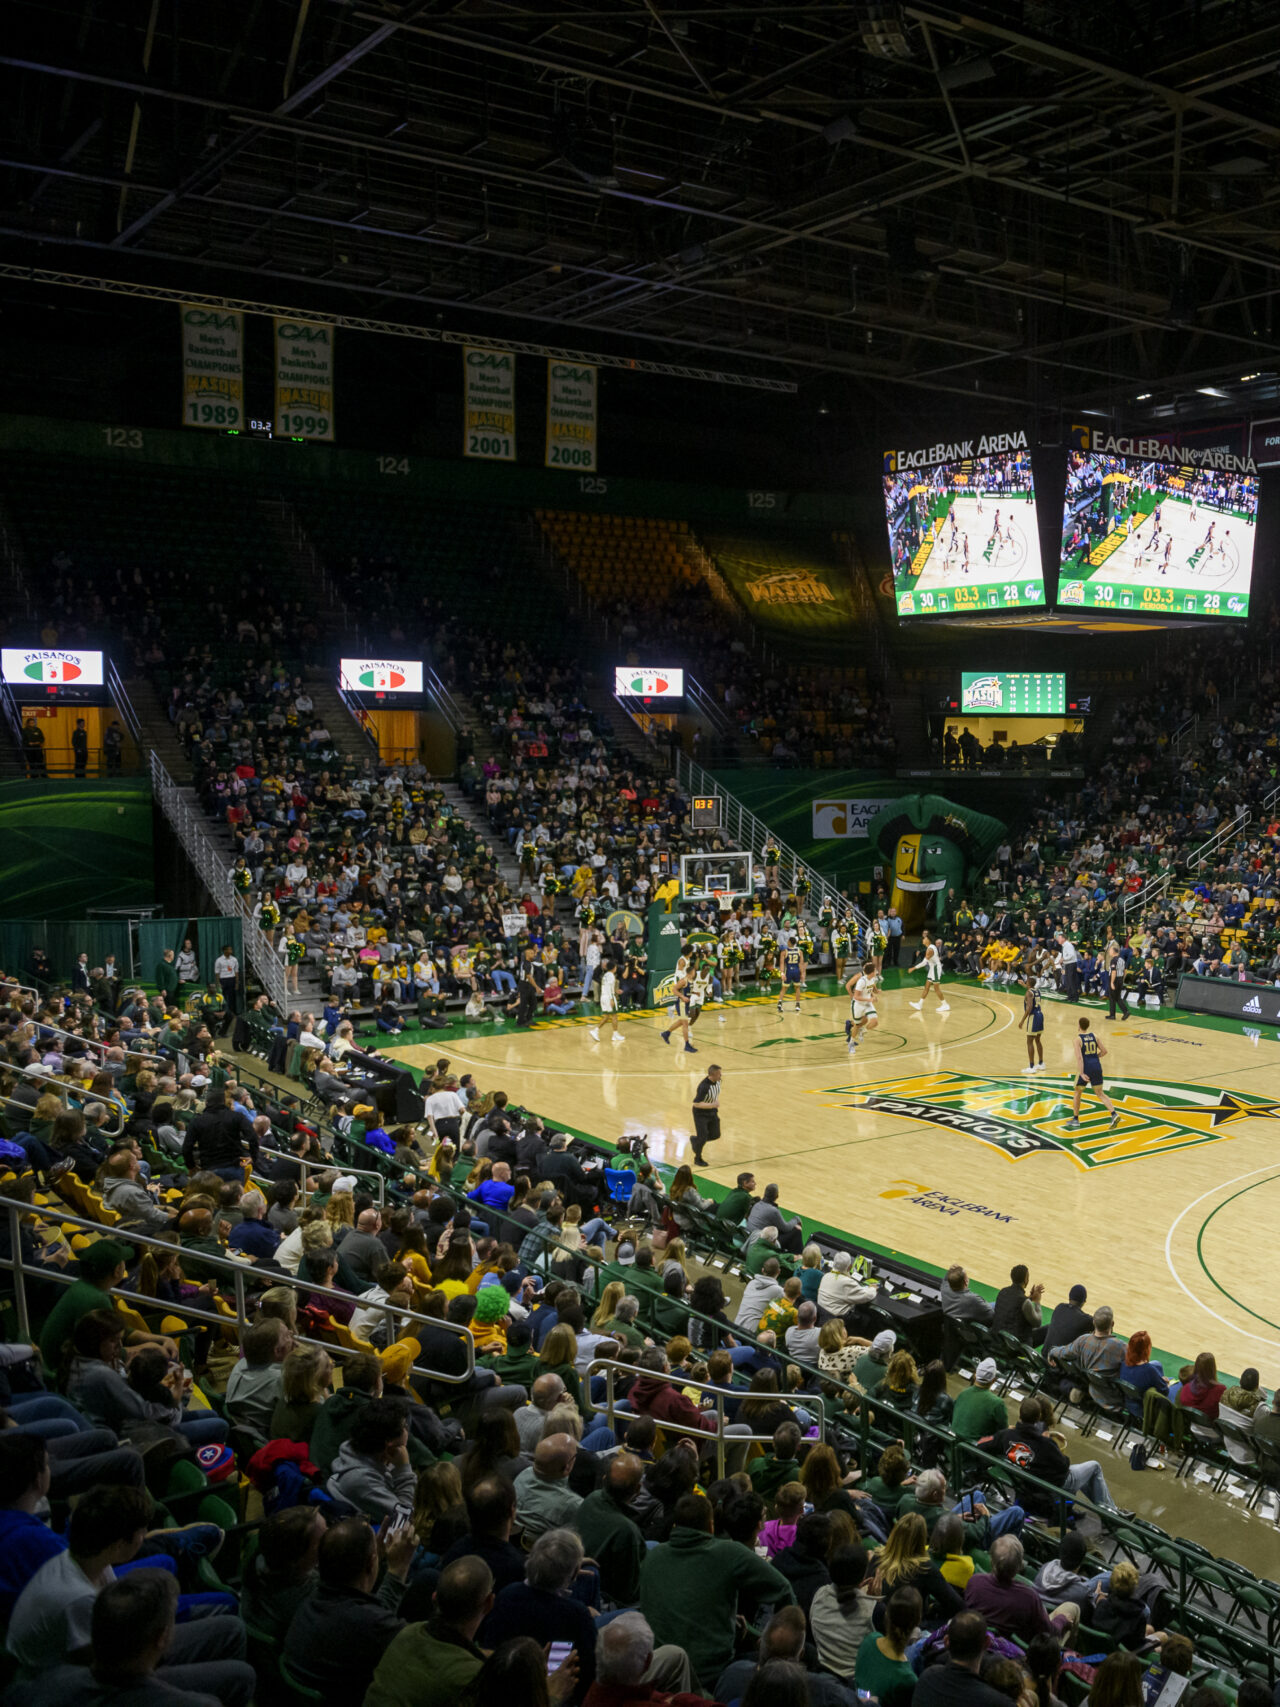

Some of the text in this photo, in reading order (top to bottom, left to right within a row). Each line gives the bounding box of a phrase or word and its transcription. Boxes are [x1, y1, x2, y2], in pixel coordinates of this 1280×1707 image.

[185, 359, 241, 373] CHAMPIONS
[279, 371, 331, 386] CHAMPIONS
[189, 403, 239, 425] 1989
[250, 420, 272, 431] 03.2
[281, 414, 329, 435] 1999
[103, 428, 143, 449] 123
[469, 436, 510, 456] 2001
[551, 446, 592, 466] 2008
[897, 431, 1028, 470] EAGLEBANK ARENA
[1092, 431, 1258, 474] EAGLEBANK ARENA
[376, 457, 411, 475] 124
[577, 476, 608, 494] 125
[746, 492, 776, 509] 125
[745, 580, 835, 602] MASON
[954, 587, 980, 602] 03.3
[1004, 585, 1019, 600] 28
[1095, 586, 1114, 601] 30
[1143, 587, 1174, 603] 03.3
[920, 593, 934, 607] 30
[1203, 594, 1221, 608] 28
[24, 651, 82, 666] PAISANO'S
[359, 661, 406, 674] PAISANO'S
[787, 953, 799, 965] 12
[1242, 1005, 1263, 1015] adidas
[1084, 1041, 1097, 1055] 10
[836, 1070, 1210, 1165] MASON
[870, 1100, 1041, 1150] PATRIOTS
[903, 1196, 961, 1217] ARENA
[923, 1190, 1020, 1224] EAGLEBANK
